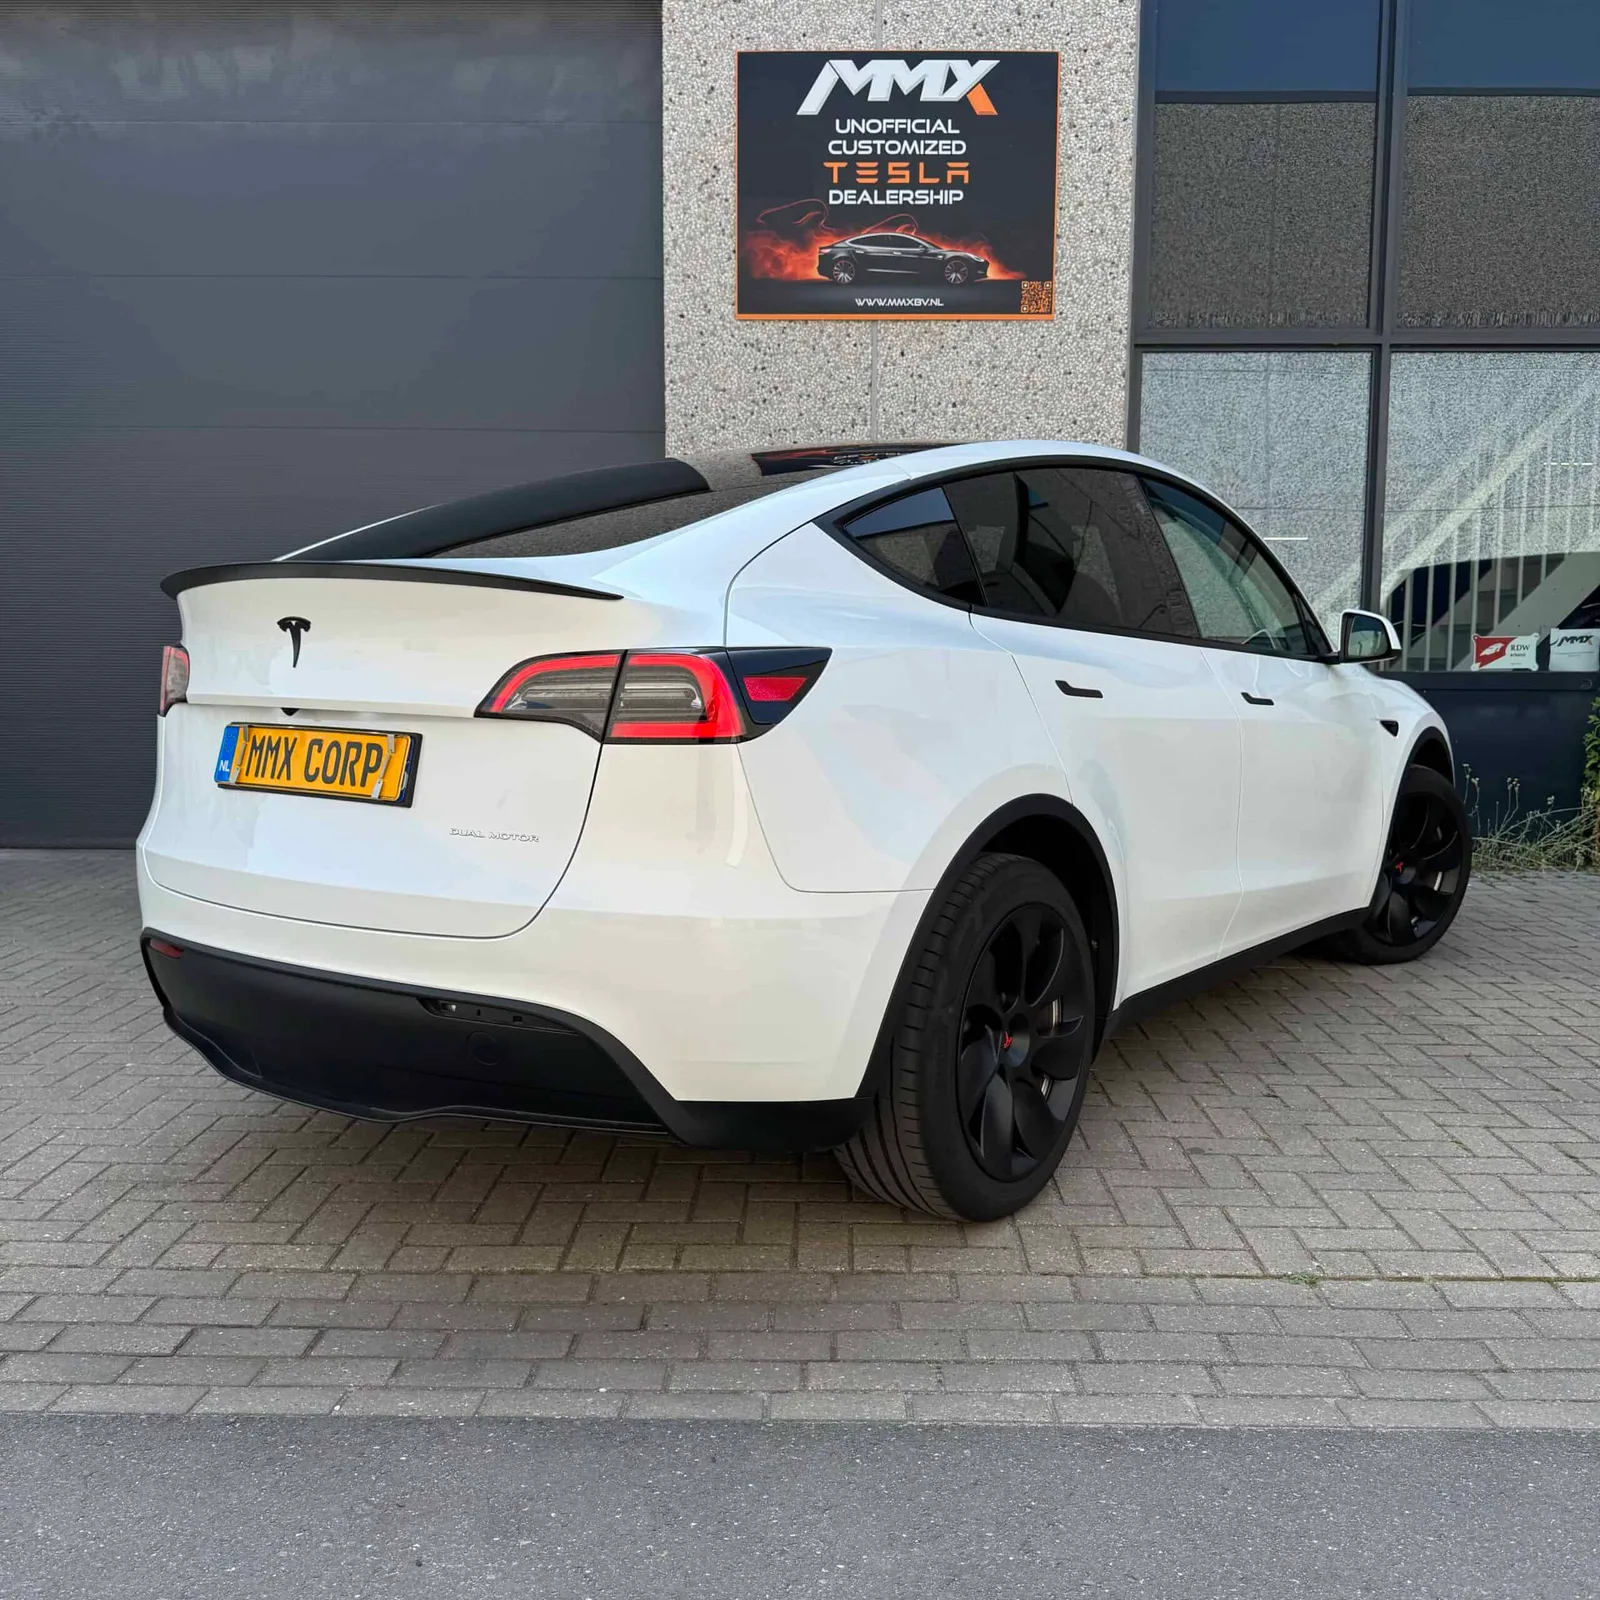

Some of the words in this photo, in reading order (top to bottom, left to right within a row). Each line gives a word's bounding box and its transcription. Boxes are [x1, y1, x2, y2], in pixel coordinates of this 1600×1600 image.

[796, 59, 1000, 115] MMX
[835, 118, 960, 134] UNOFFICIAL
[828, 140, 967, 155] CUSTOMIZED
[823, 162, 970, 184] TESLA
[828, 189, 964, 205] DEALERSHIP
[855, 298, 944, 306] WWW.MMXBV.NL
[1557, 635, 1594, 647] MMX
[219, 760, 230, 772] NL
[245, 734, 298, 781] MMX
[303, 738, 383, 788] CORP
[449, 827, 486, 838] DUAL
[488, 831, 540, 842] MOTOR
